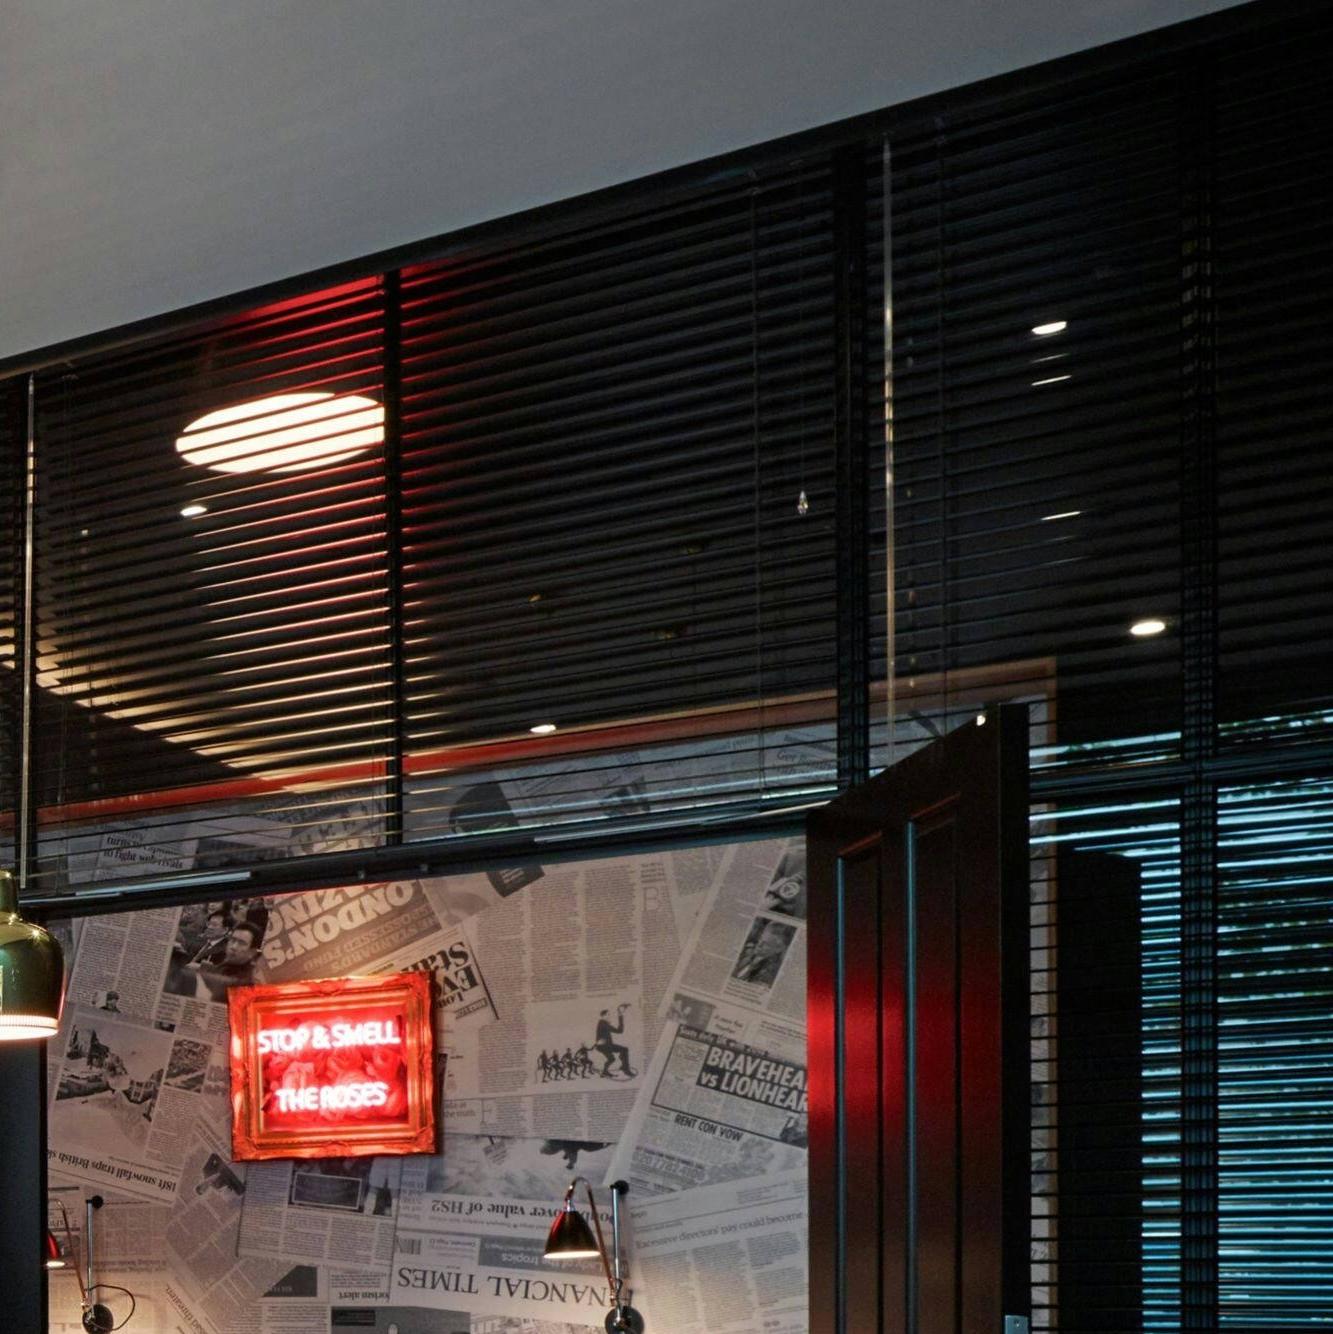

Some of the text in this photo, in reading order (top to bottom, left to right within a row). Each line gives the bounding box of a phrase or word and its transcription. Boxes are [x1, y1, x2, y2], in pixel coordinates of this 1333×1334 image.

[257, 1020, 401, 1054] STOP & SMELL
[706, 1046, 807, 1092] BRAVEHEA
[275, 1081, 389, 1113] THE ROSES
[699, 1072, 808, 1114] vs LIONHEAR
[674, 1114, 744, 1142] RENT CON VOW
[53, 1150, 90, 1168] British
[89, 1160, 115, 1176] traps
[114, 1166, 157, 1186] snowfall
[157, 1178, 177, 1192] 18ft
[430, 1199, 463, 1212] HS2
[467, 1202, 482, 1214] of
[486, 1203, 525, 1217] value
[739, 1215, 765, 1232] could
[766, 1210, 804, 1226] become
[500, 1252, 538, 1265] tropics
[396, 1266, 478, 1294] TIMES
[338, 1290, 359, 1299] alert
